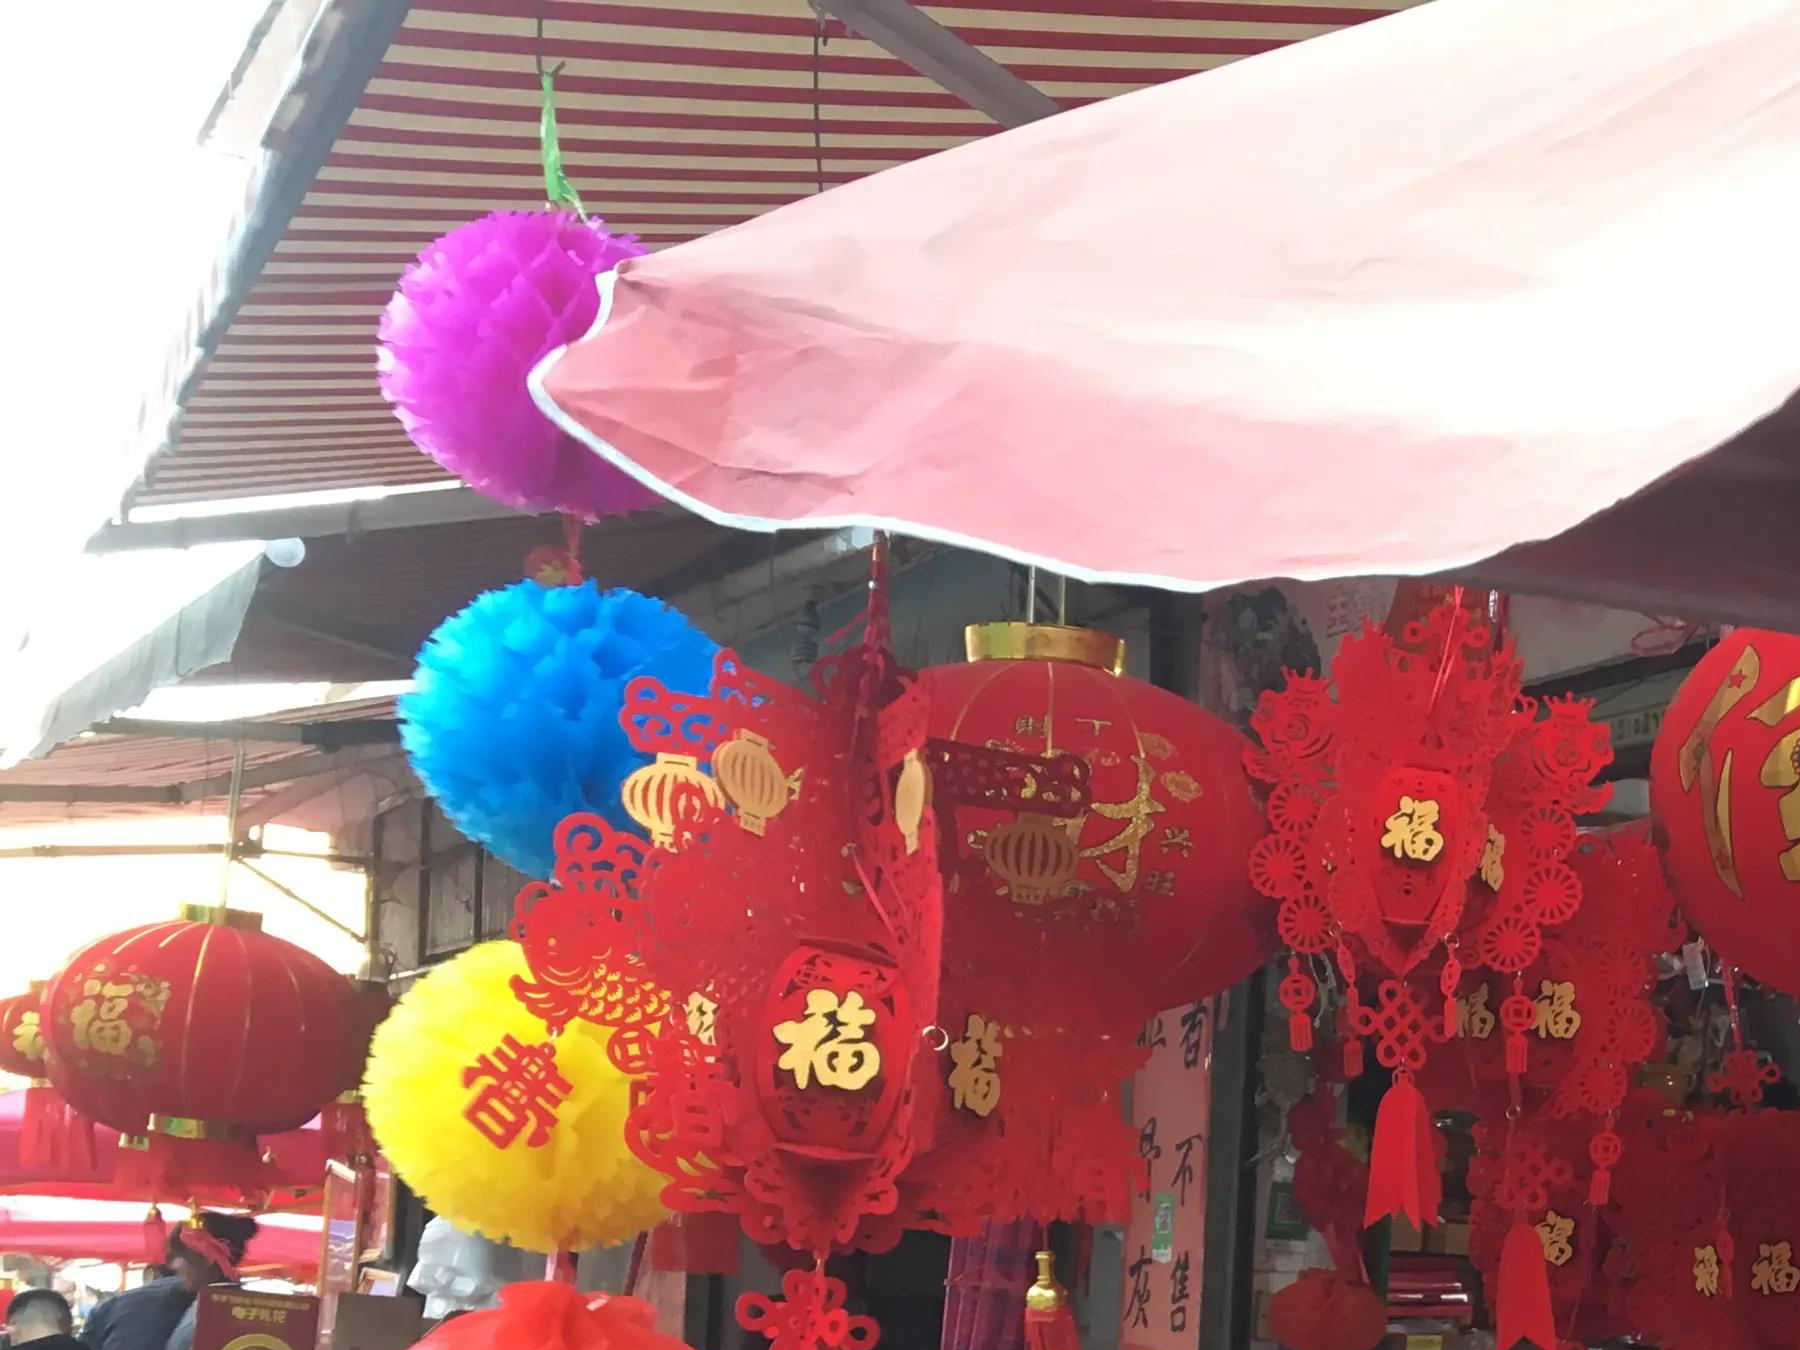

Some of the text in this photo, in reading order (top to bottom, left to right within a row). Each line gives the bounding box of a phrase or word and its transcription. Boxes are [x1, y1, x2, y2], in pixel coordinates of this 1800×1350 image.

[1381, 796, 1444, 861] 福
[70, 977, 136, 1055] 福
[773, 988, 881, 1091] 福
[1534, 979, 1582, 1040] 福
[949, 1013, 1003, 1117] 福
